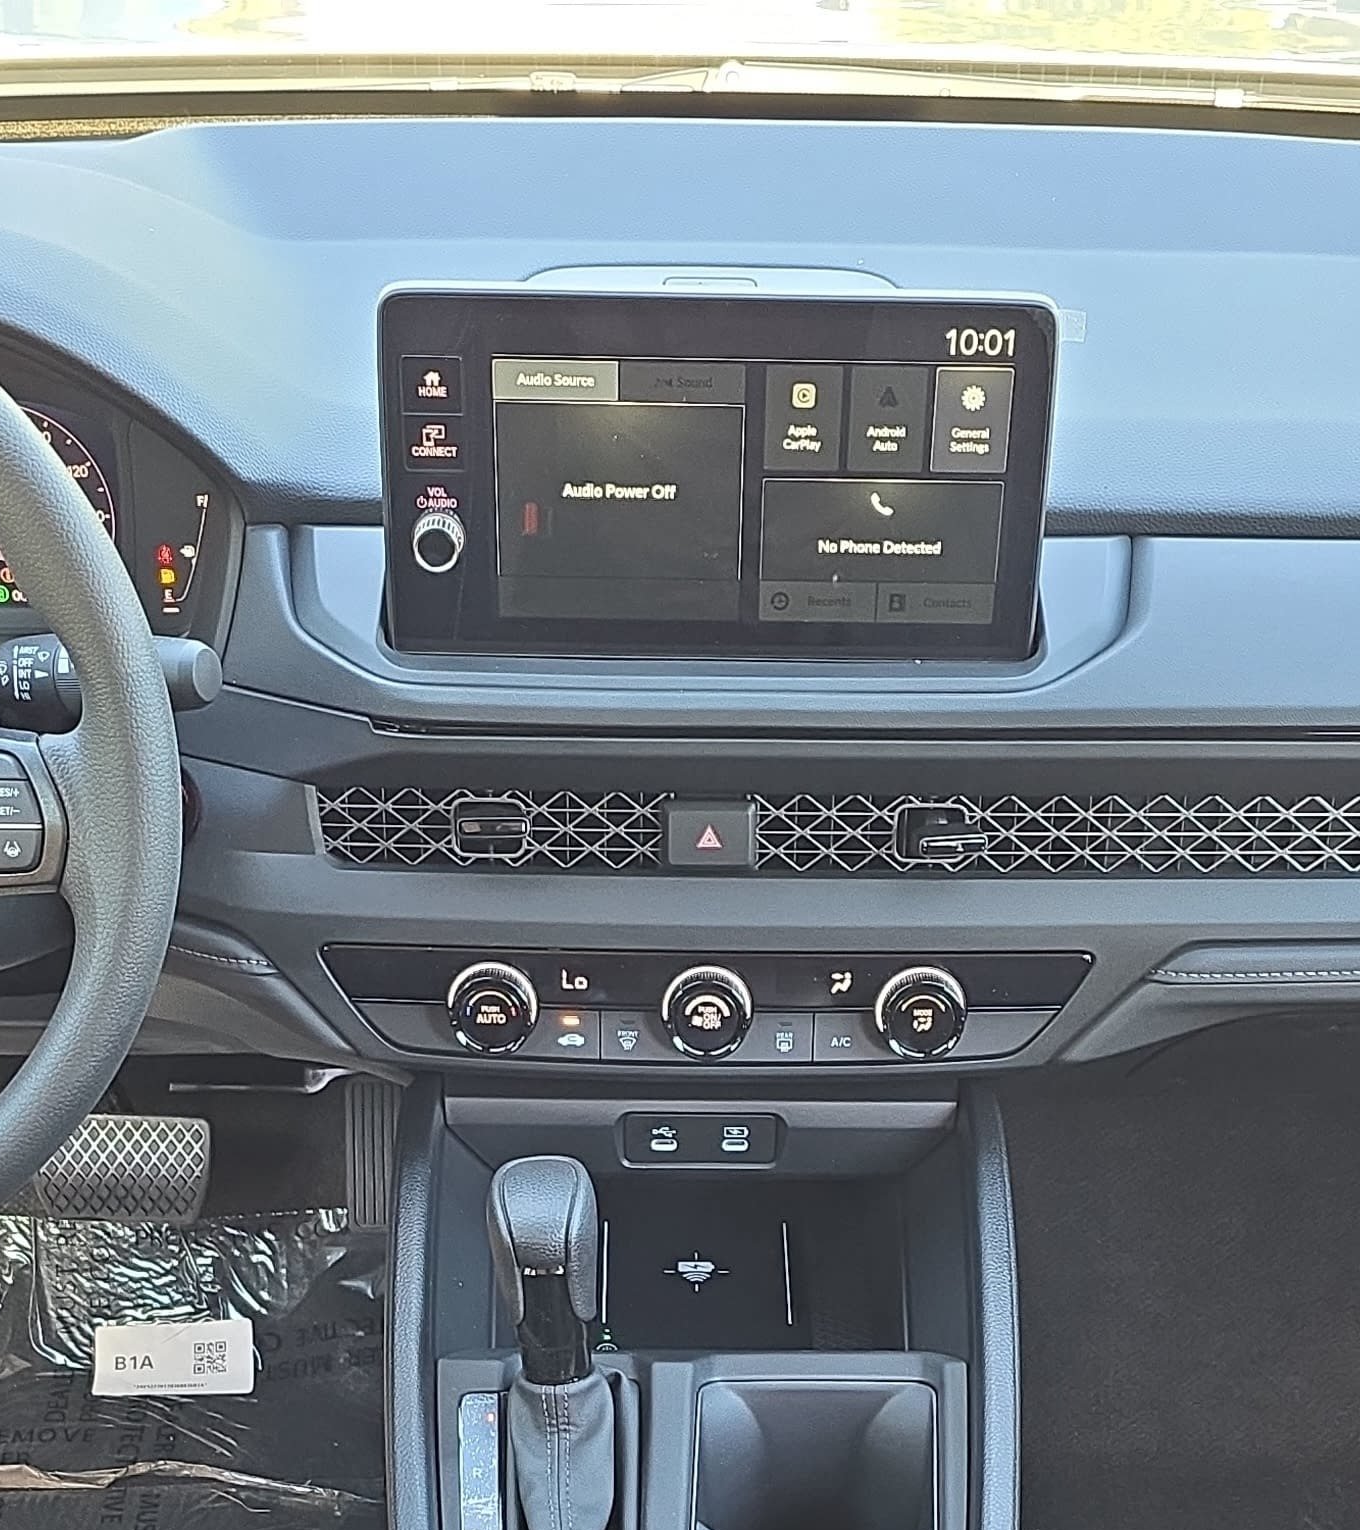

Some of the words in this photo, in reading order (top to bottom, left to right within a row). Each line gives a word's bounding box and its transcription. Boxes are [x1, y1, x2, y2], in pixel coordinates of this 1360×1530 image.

[945, 328, 1016, 357] 10:01
[517, 373, 552, 387] Audio
[553, 374, 595, 388] Source
[418, 387, 447, 398] HOME
[787, 425, 818, 438] Apple
[866, 425, 906, 439] Android
[951, 427, 990, 440] General
[782, 437, 822, 453] CarPlay
[872, 439, 899, 452] Auto
[949, 441, 990, 455] Settings
[412, 446, 458, 458] CONNECT
[427, 487, 447, 498] VOL
[562, 482, 603, 498] Audio
[605, 484, 650, 499] Power
[652, 484, 677, 500] Off
[428, 498, 458, 509] AUDIO
[818, 539, 838, 554] No
[840, 540, 880, 554] Phone
[883, 541, 942, 555] Detected
[18, 657, 35, 668] OFF
[18, 669, 32, 679] INT
[19, 681, 30, 690] LO
[561, 969, 589, 990] Lo
[476, 1014, 507, 1025] AUTO
[703, 1021, 722, 1030] OFF
[830, 1037, 852, 1048] A/C
[114, 1355, 155, 1371] B1A
